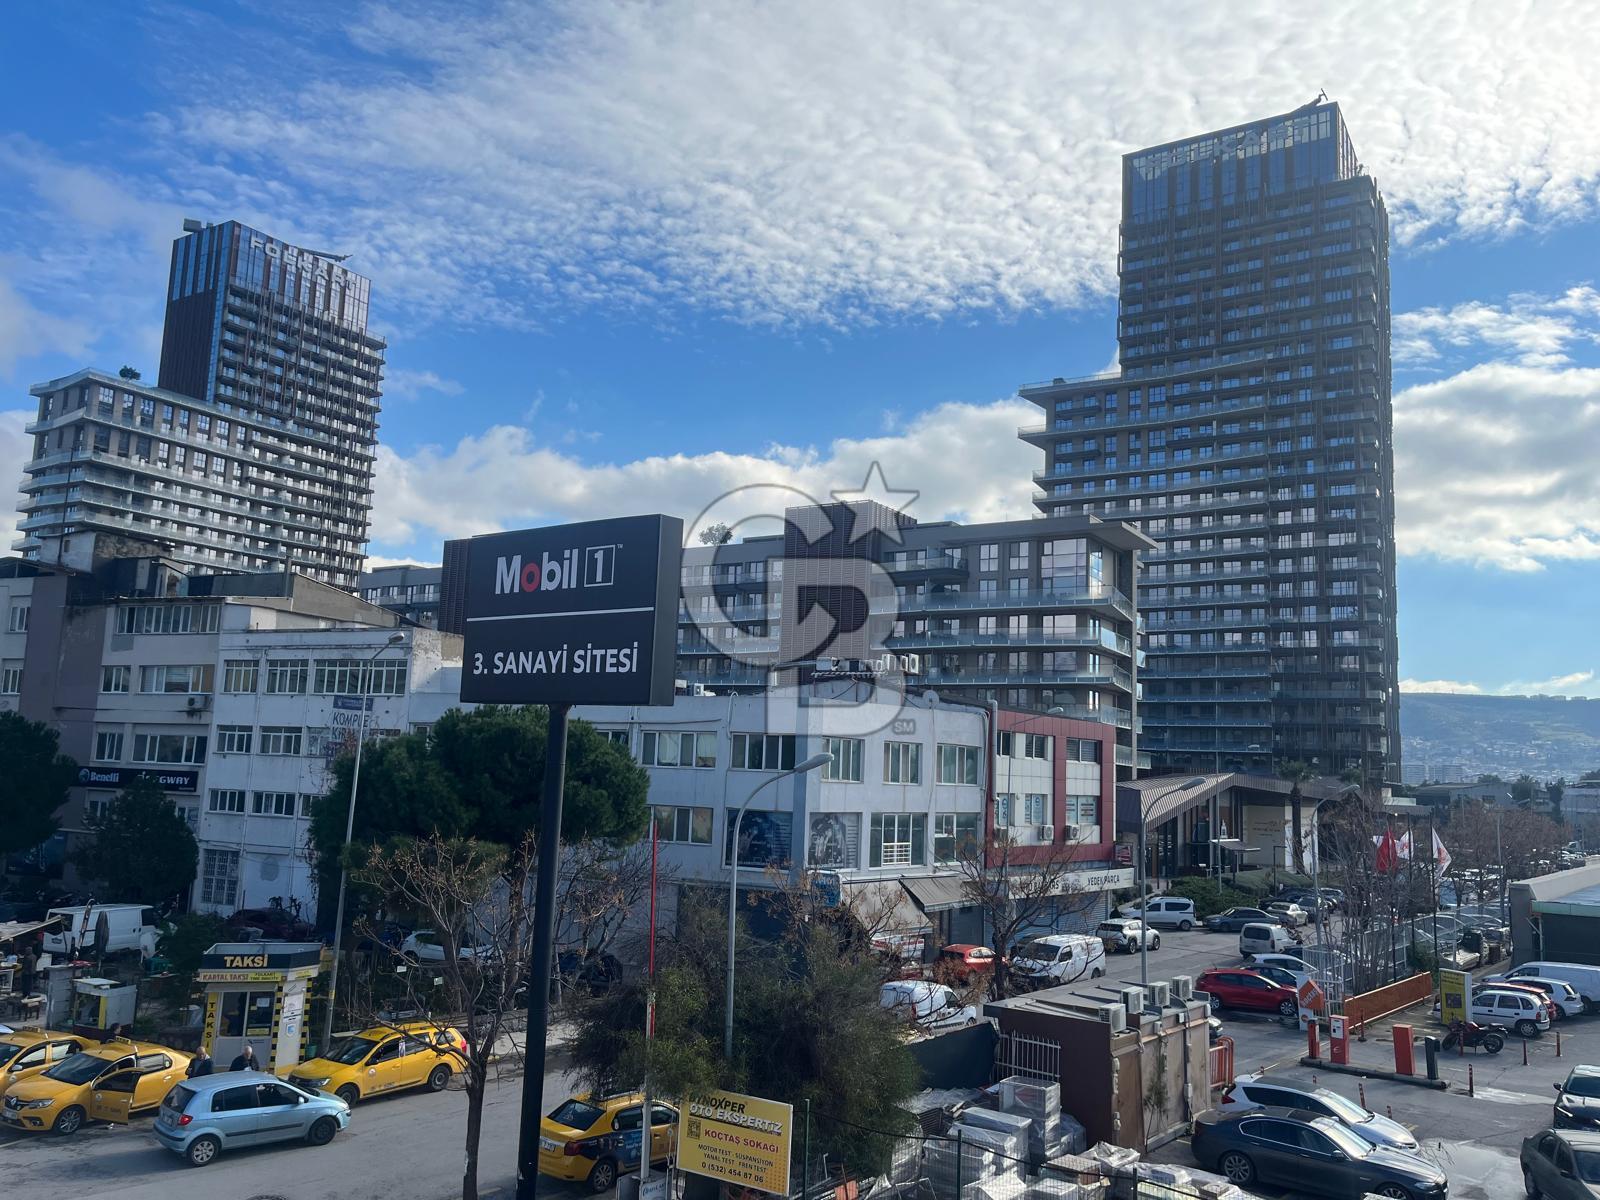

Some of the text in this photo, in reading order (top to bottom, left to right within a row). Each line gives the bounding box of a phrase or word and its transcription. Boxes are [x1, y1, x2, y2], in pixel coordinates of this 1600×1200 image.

[495, 548, 579, 594] Mobil
[473, 641, 638, 675] 3. SANAYİ SİTESİ
[90, 771, 119, 783] Benelli
[224, 954, 268, 968] TAKSİ
[689, 1103, 713, 1118] OTO
[704, 1128, 741, 1146] KOÇTAŞ
[698, 1144, 718, 1154] MOTOR
[718, 1148, 732, 1157] TEST
[722, 1157, 735, 1166] TEST
